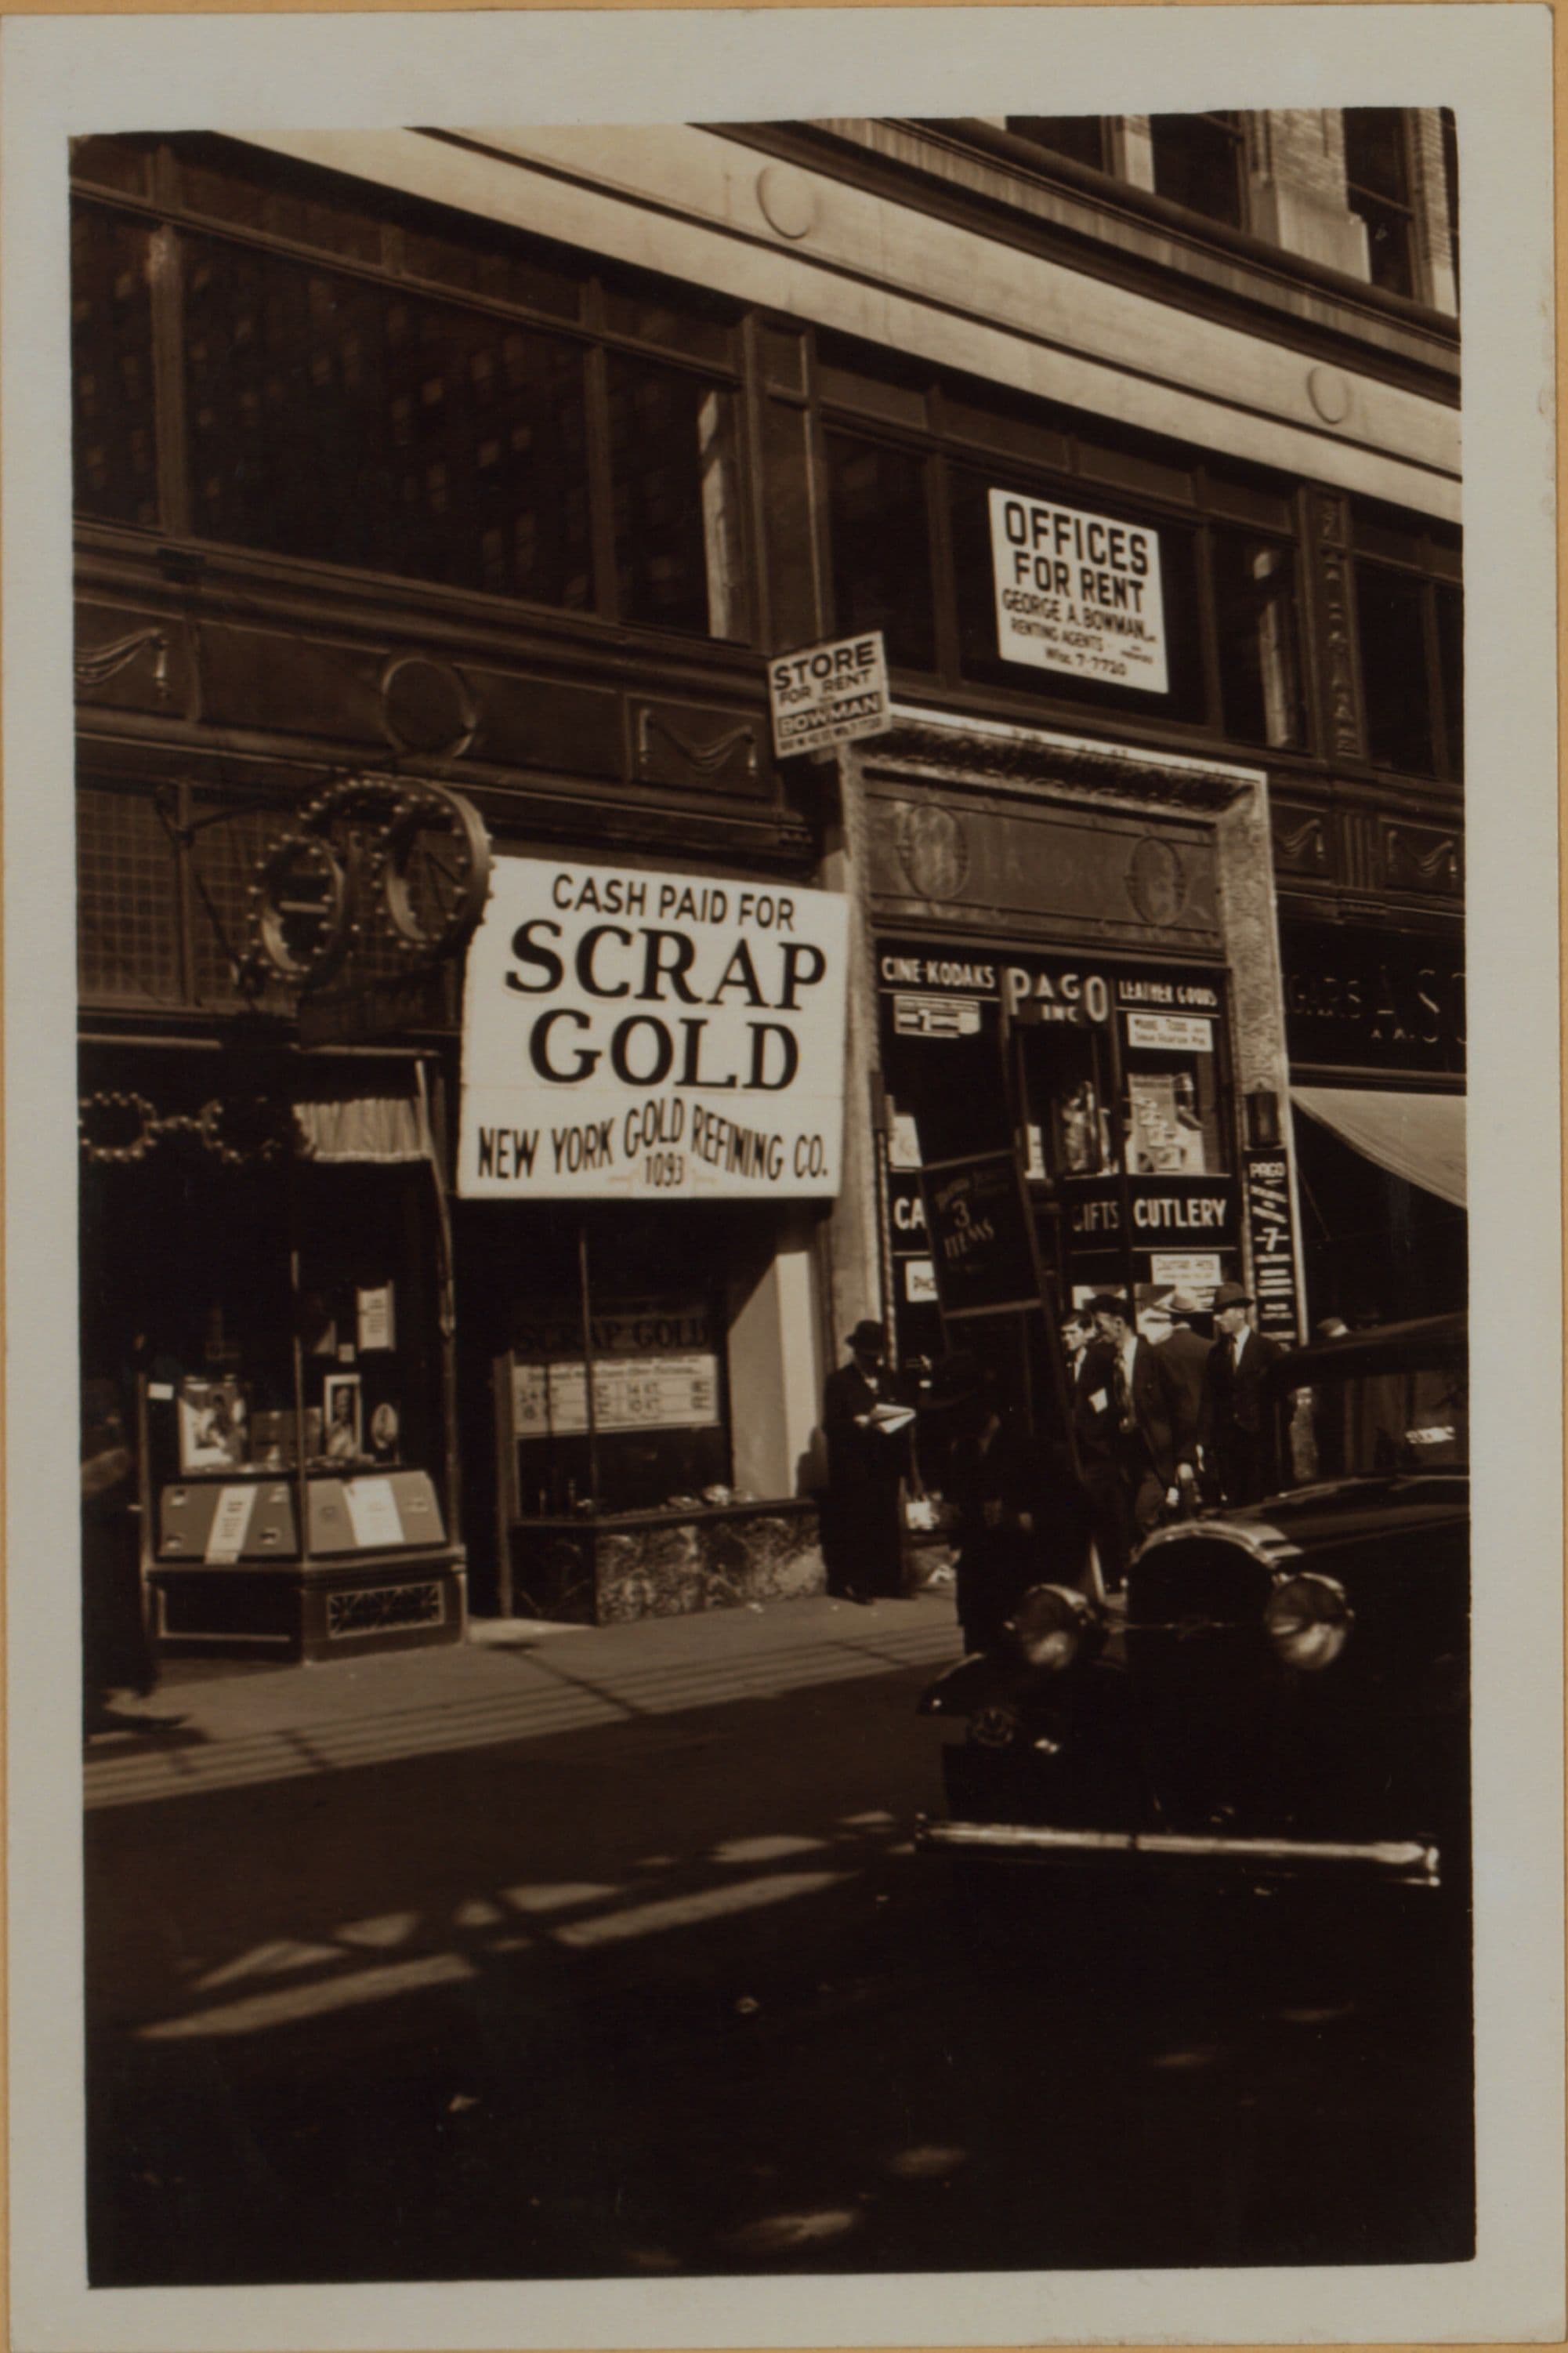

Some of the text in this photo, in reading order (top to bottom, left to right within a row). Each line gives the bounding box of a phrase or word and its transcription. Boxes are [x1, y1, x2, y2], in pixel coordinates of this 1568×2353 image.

[1005, 501, 1149, 576] OFFICES
[1002, 589, 1061, 622] GEORGE
[1067, 604, 1080, 625] A.
[1014, 551, 1143, 613] FOR RENT
[774, 641, 875, 691] STORE
[1062, 630, 1104, 652] AGENTS
[780, 669, 871, 706] FOR RENT
[782, 694, 879, 737] BOWMAN
[552, 874, 795, 931] CASH PAID FOR
[505, 919, 827, 1011] SCRAP
[1008, 967, 1108, 1022] PAGO
[1041, 1004, 1078, 1022] INC
[529, 1009, 799, 1091] GOLD
[478, 1097, 828, 1180] NEW YORK GOLD REFINING CO.
[644, 1152, 683, 1187] 1093
[1134, 1198, 1227, 1227] CUTLERY
